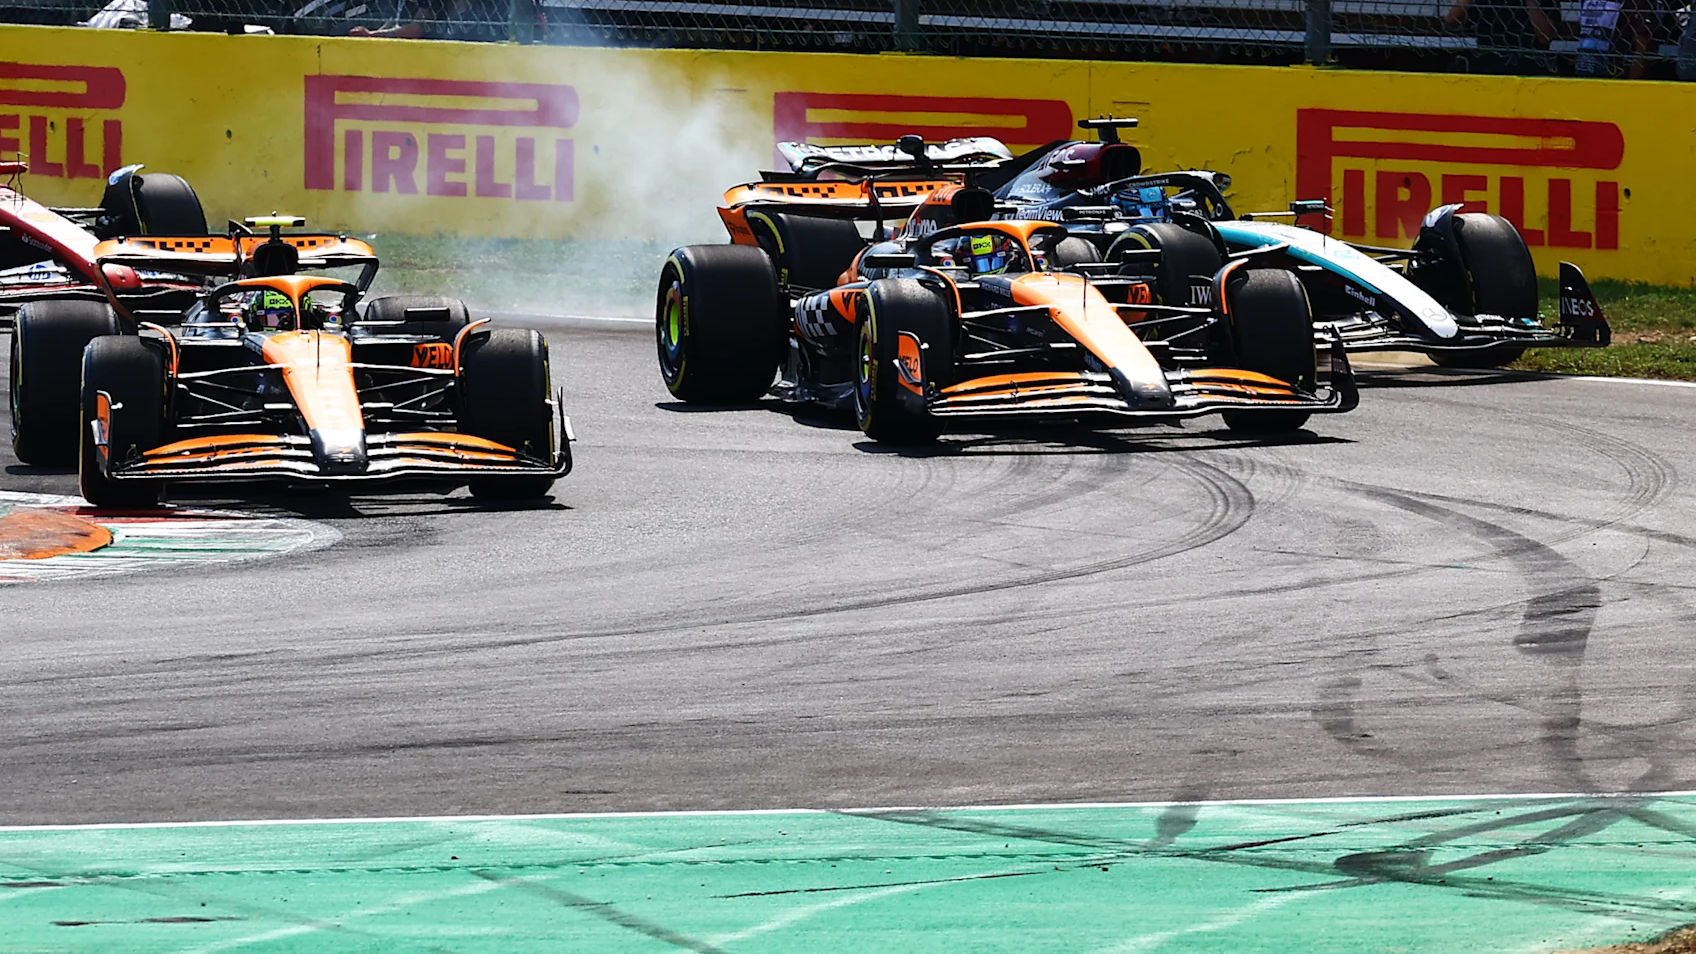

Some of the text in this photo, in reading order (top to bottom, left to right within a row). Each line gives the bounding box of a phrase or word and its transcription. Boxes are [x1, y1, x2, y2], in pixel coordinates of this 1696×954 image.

[304, 74, 580, 202] PIRELLI
[1127, 178, 1170, 189] CROWDSTRIKE
[1296, 108, 1624, 251] PIRELLI
[1015, 206, 1065, 221] TeamView
[1191, 286, 1212, 305] IW
[1345, 284, 1375, 307] Einhell
[1561, 297, 1594, 318] INEOS
